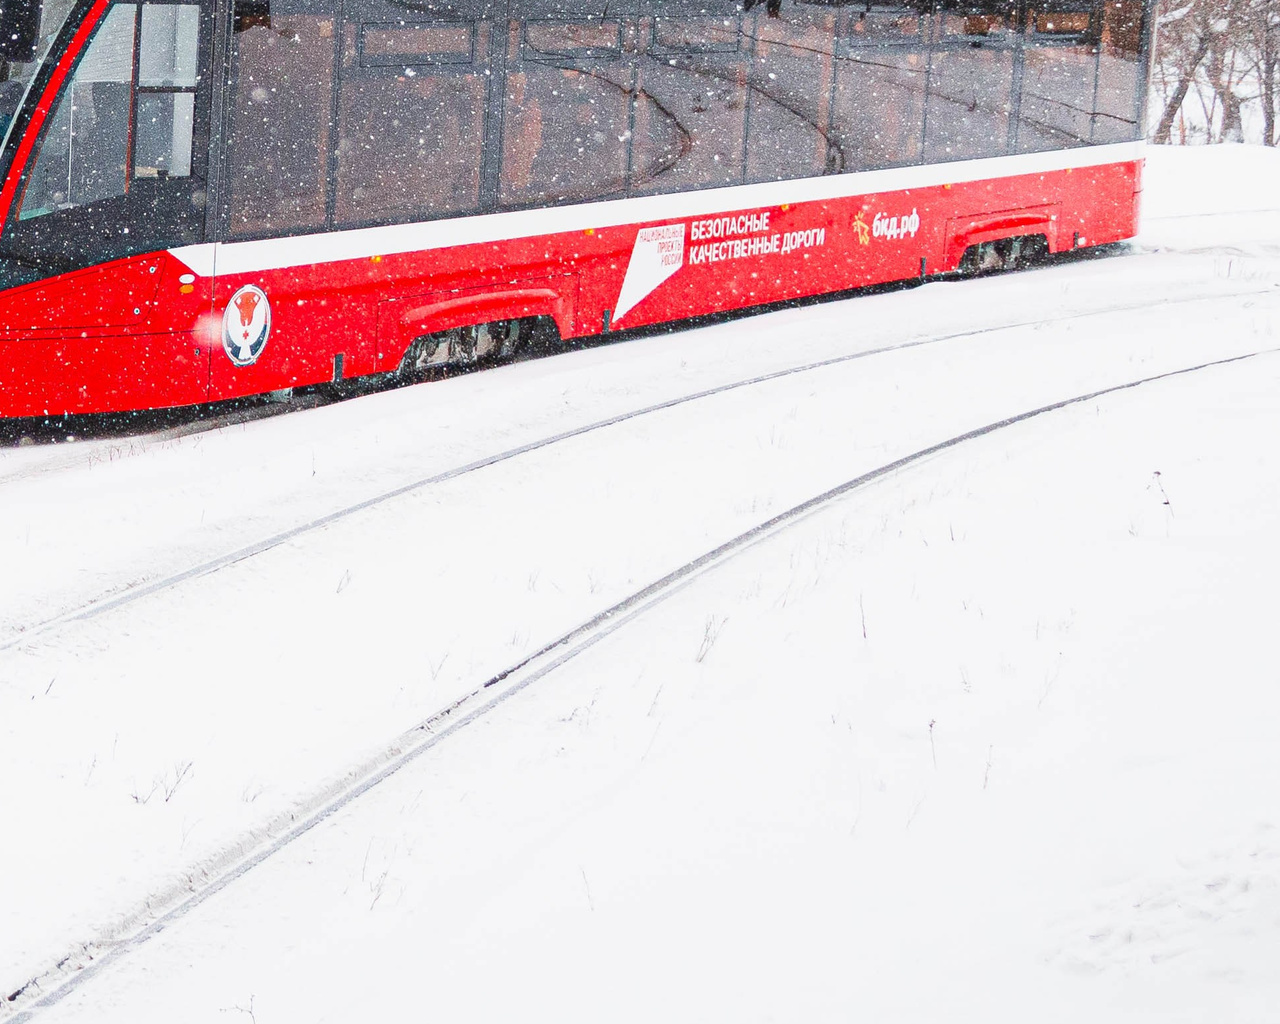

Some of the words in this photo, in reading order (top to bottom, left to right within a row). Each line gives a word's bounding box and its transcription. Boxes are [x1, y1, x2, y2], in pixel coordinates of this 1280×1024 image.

[690, 212, 770, 241] БЕЗОПАСНЫЕ
[872, 207, 920, 240] бкд.рф
[689, 234, 781, 265] КАЧЕСТВЕННЫЕ
[780, 228, 825, 255] ДОРОГИ
